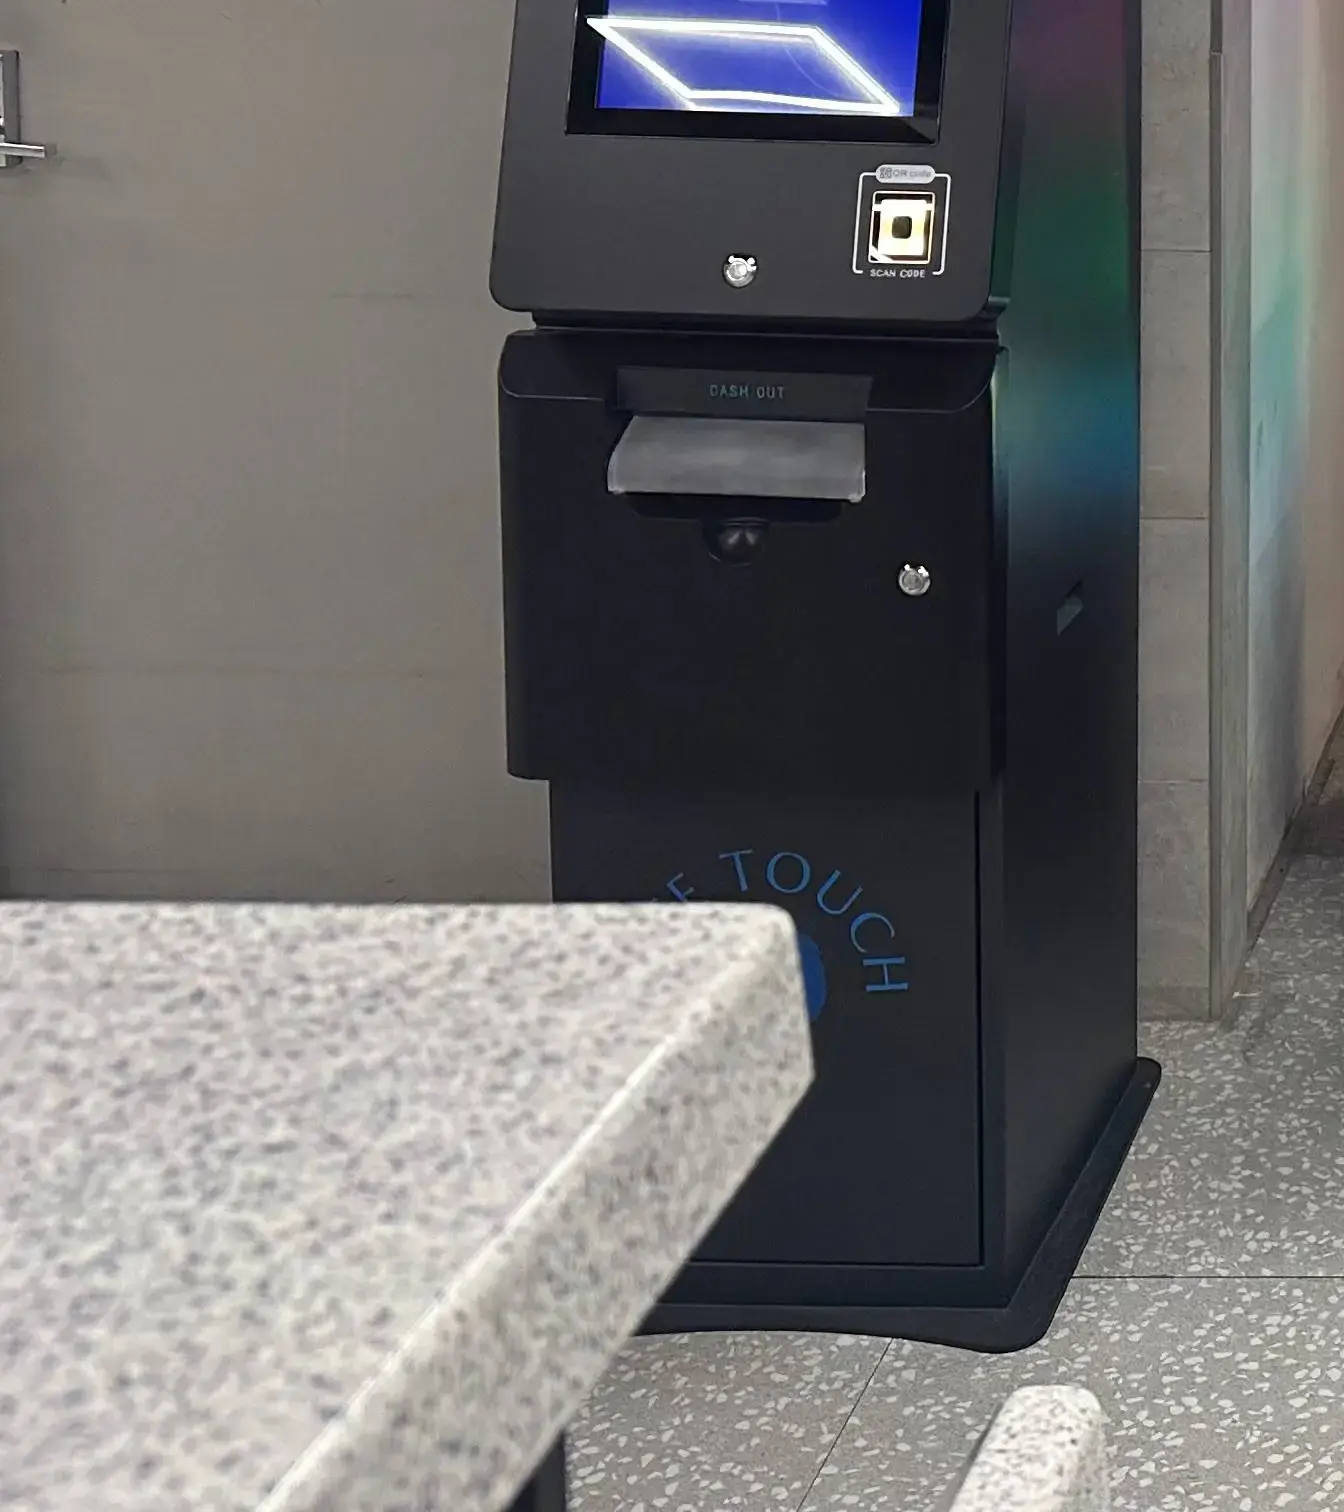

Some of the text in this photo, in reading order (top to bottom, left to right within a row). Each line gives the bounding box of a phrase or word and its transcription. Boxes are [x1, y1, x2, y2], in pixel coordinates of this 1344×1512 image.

[893, 169, 907, 178] QR
[870, 269, 926, 278] SCAN CODE
[756, 385, 785, 399] OUT
[719, 848, 909, 993] TOUCH
